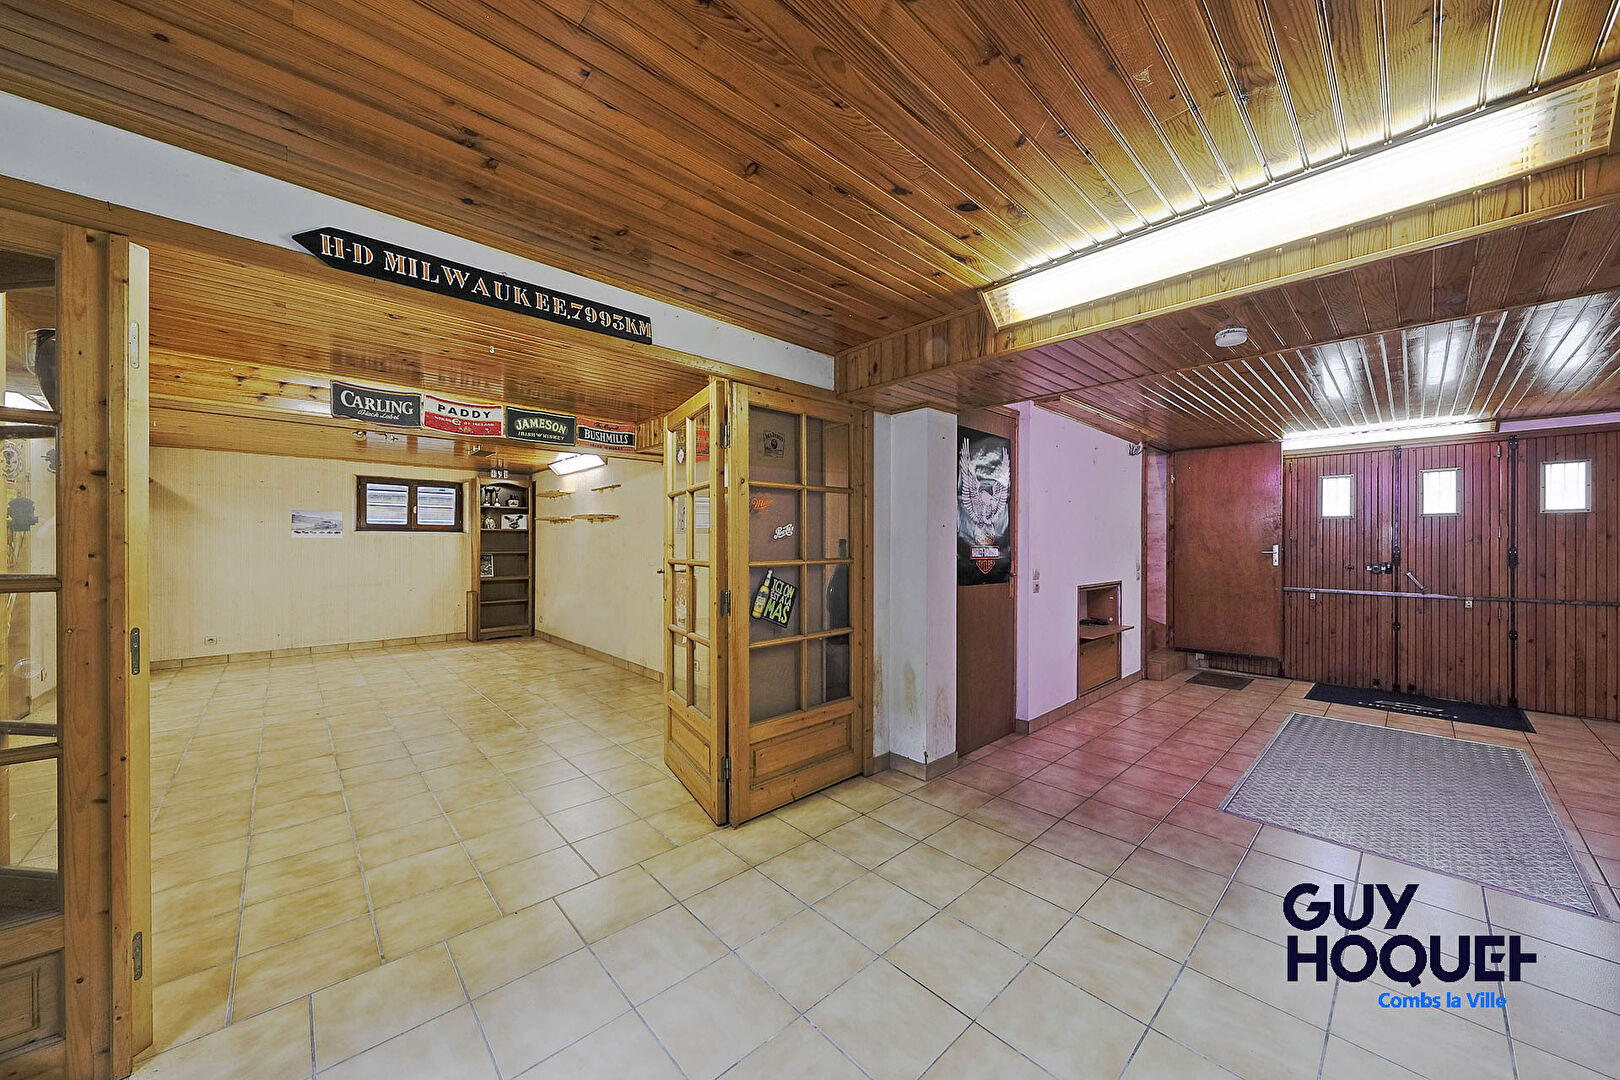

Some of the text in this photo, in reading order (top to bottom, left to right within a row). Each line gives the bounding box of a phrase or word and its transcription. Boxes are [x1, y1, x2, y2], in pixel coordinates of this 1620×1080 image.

[320, 233, 374, 265] H-D
[437, 404, 491, 418] PADDY
[515, 418, 567, 434] JAMESON
[584, 428, 629, 444] BUSHMILLS
[771, 579, 795, 599] ICI ON
[770, 591, 780, 602] EST
[784, 598, 792, 607] LA
